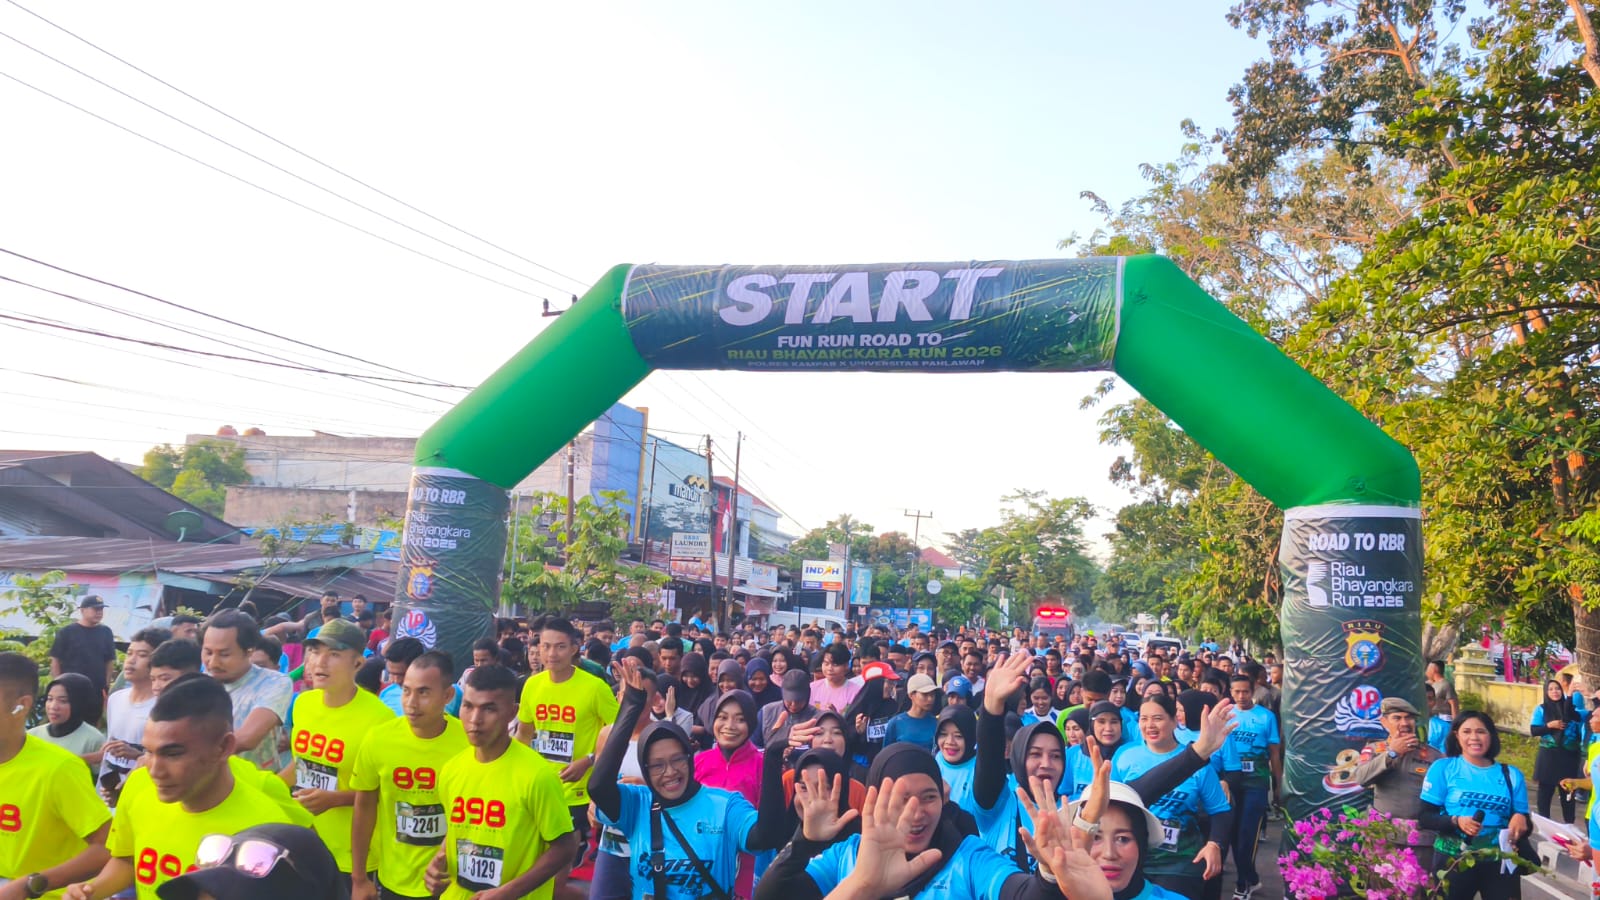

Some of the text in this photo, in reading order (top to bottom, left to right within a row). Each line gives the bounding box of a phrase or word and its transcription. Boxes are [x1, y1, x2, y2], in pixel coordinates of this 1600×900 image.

[719, 268, 1004, 326] START
[777, 332, 942, 348] FUN RUN ROAD TO
[727, 345, 1003, 360] RIAU BHAYANGKARA RUN 2026
[425, 488, 439, 502] TO
[440, 489, 466, 505] RBR
[409, 522, 470, 538] Bhayangkara
[424, 537, 457, 549] 2026
[674, 540, 708, 548] LAUNDRY
[1308, 533, 1405, 551] ROAD TO RBR
[1331, 562, 1365, 576] Riau
[1331, 577, 1413, 595] Bhayangkara
[1332, 592, 1404, 608] Run 2026
[536, 703, 577, 724] 898
[294, 729, 345, 764] 898
[393, 766, 436, 790] 89
[1459, 791, 1511, 804] ROAD
